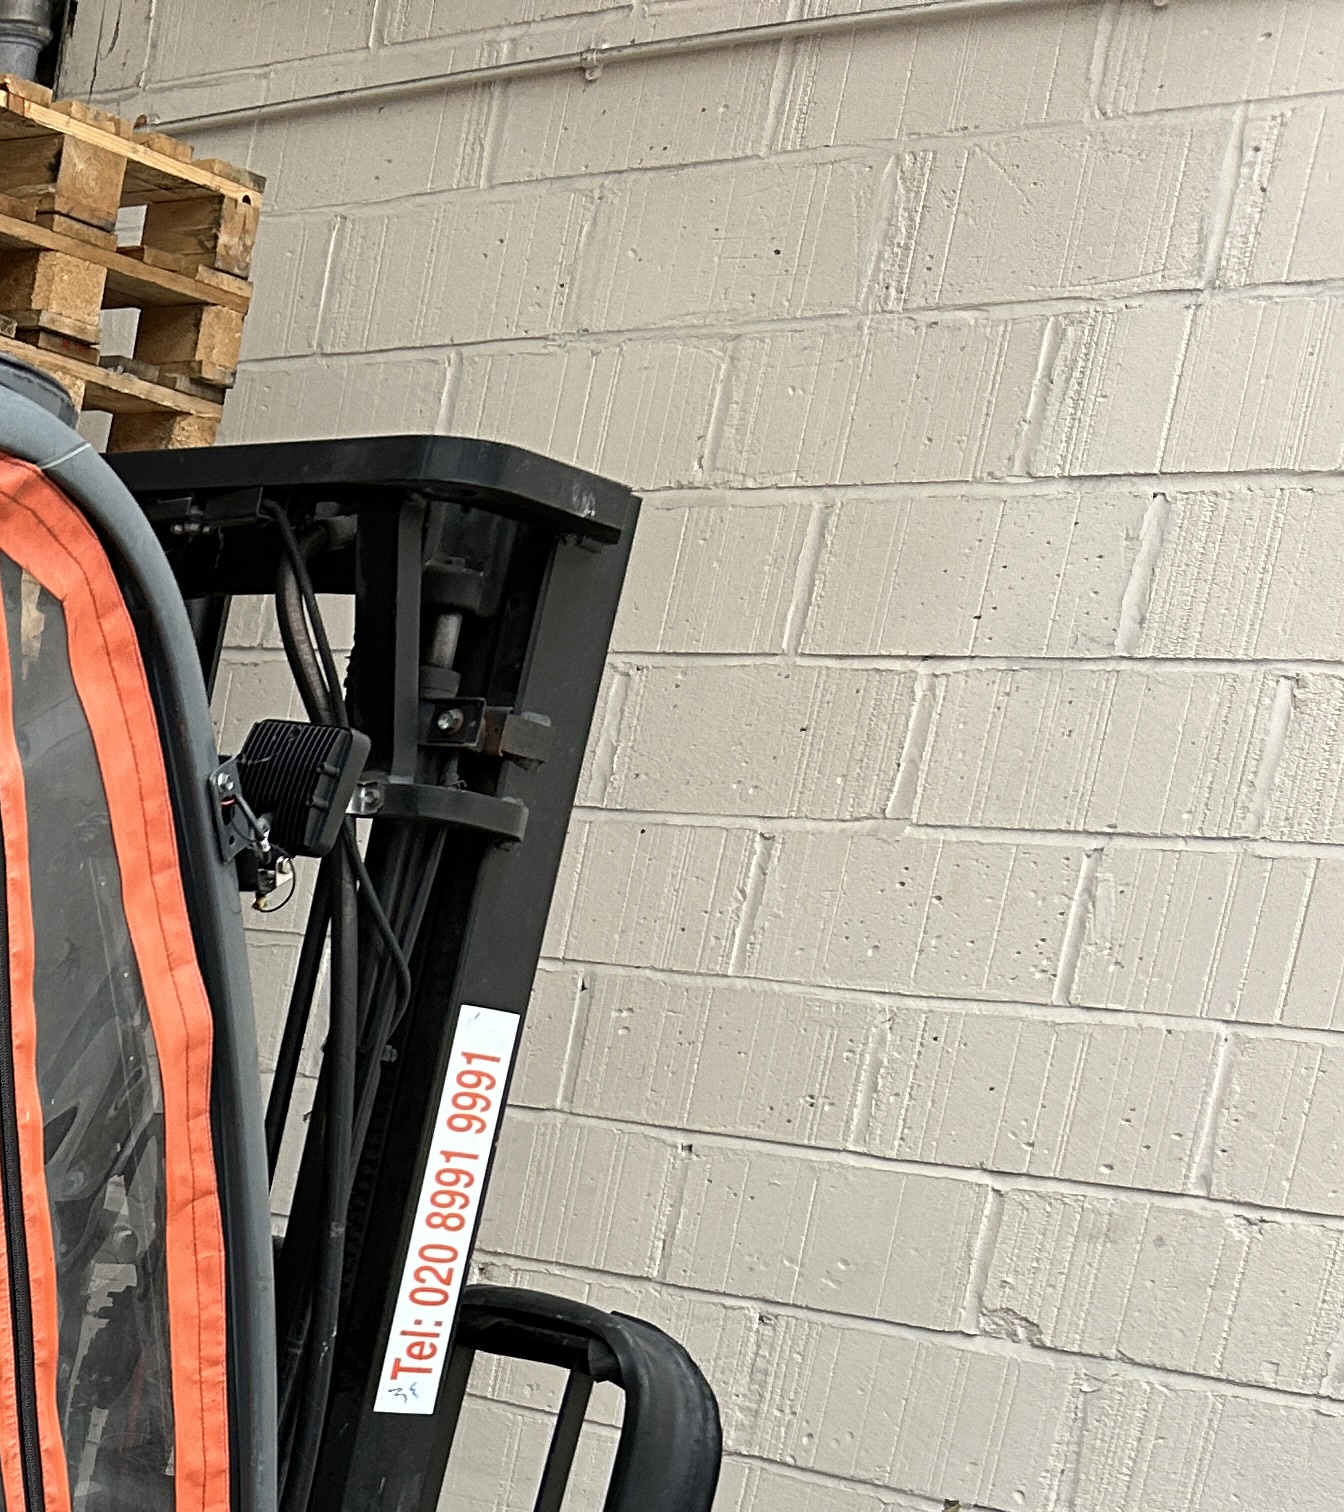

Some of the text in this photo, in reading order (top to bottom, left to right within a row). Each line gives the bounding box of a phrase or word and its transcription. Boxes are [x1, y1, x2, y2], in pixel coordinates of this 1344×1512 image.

[390, 1050, 501, 1380] Tel: 020 8991 9991
